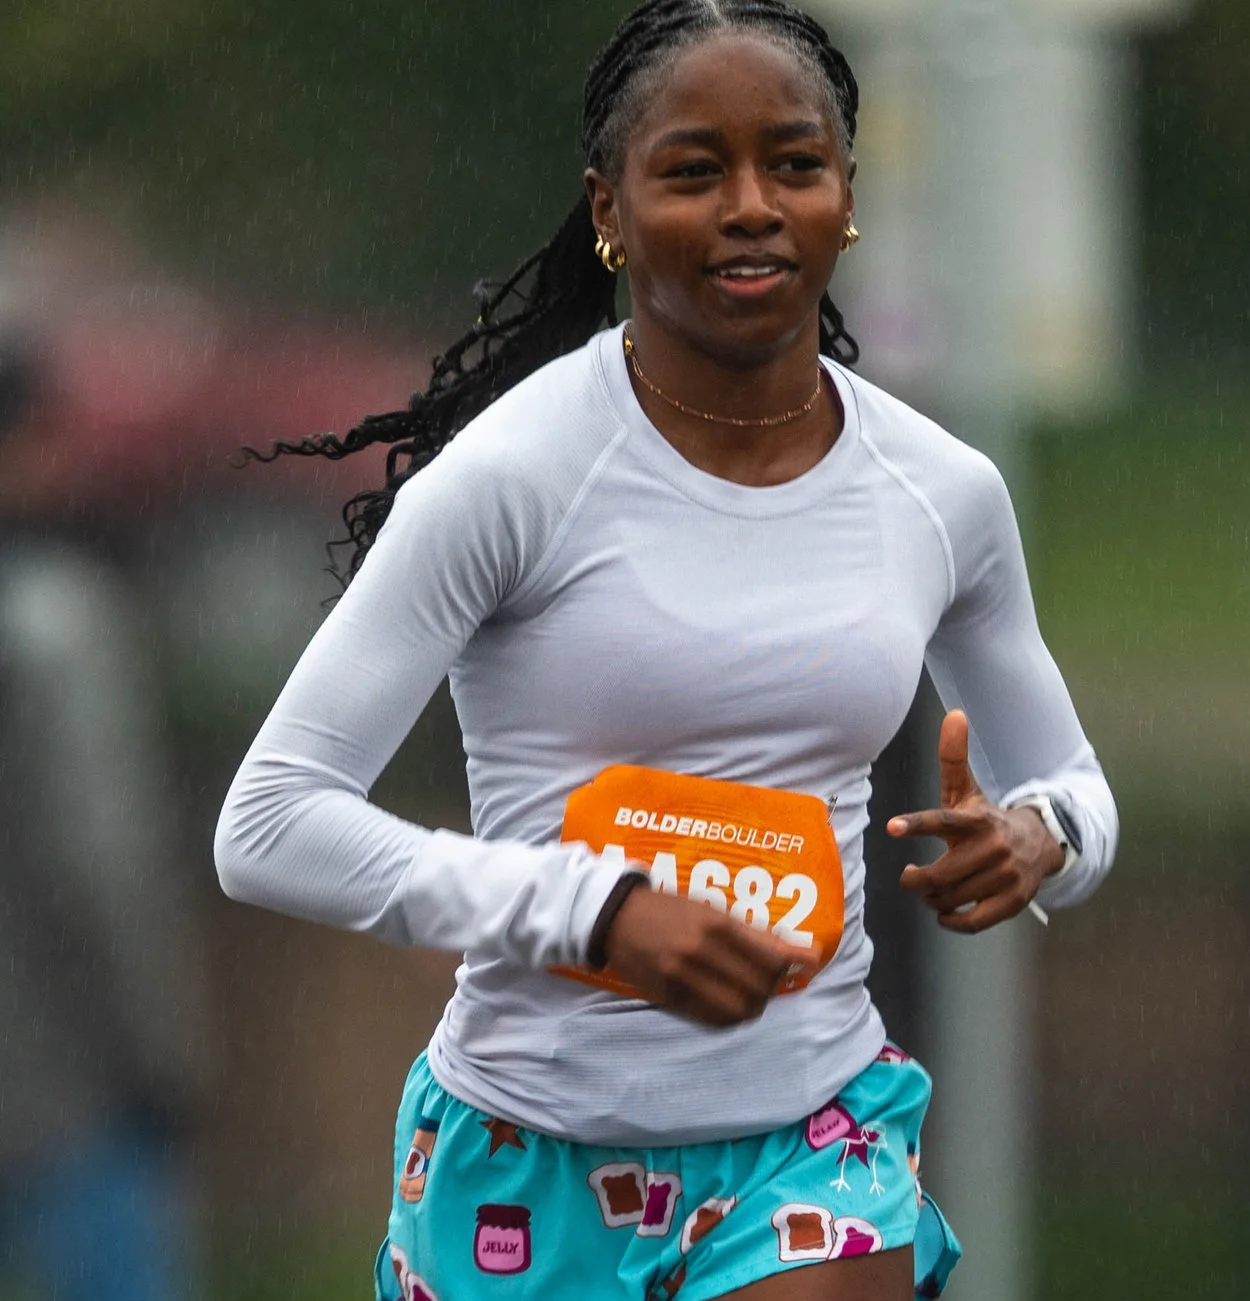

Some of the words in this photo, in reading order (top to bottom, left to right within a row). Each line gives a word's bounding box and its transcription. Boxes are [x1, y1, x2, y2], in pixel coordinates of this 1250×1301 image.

[614, 807, 805, 854] BOLDERBOULDER
[600, 843, 819, 949] A682
[482, 1241, 519, 1255] JELLY
